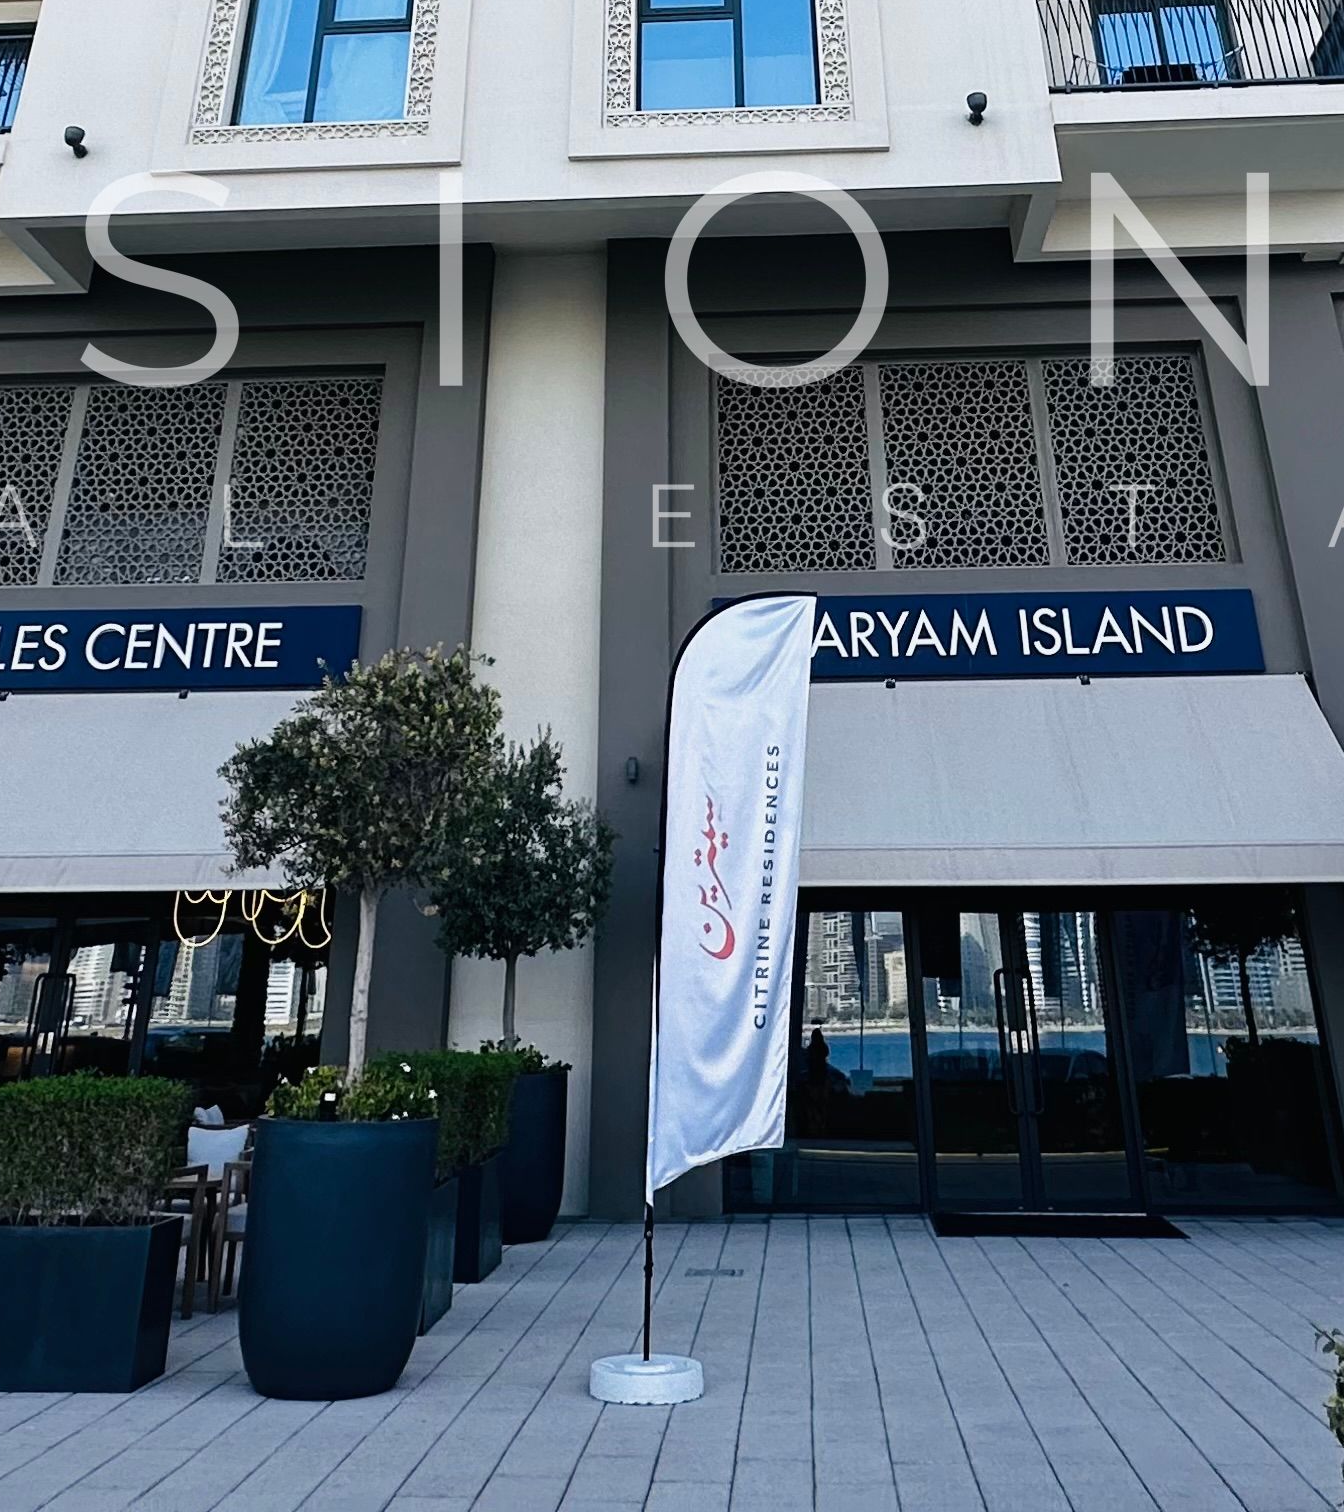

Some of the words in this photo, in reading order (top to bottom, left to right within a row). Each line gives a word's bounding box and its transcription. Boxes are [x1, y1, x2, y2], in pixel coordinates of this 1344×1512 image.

[85, 622, 283, 670] CENTRE
[811, 608, 998, 658] ARYAM
[1018, 605, 1215, 656] ISLAND
[760, 745, 780, 905] RESIDENCES
[754, 917, 771, 1029] CITRINE
